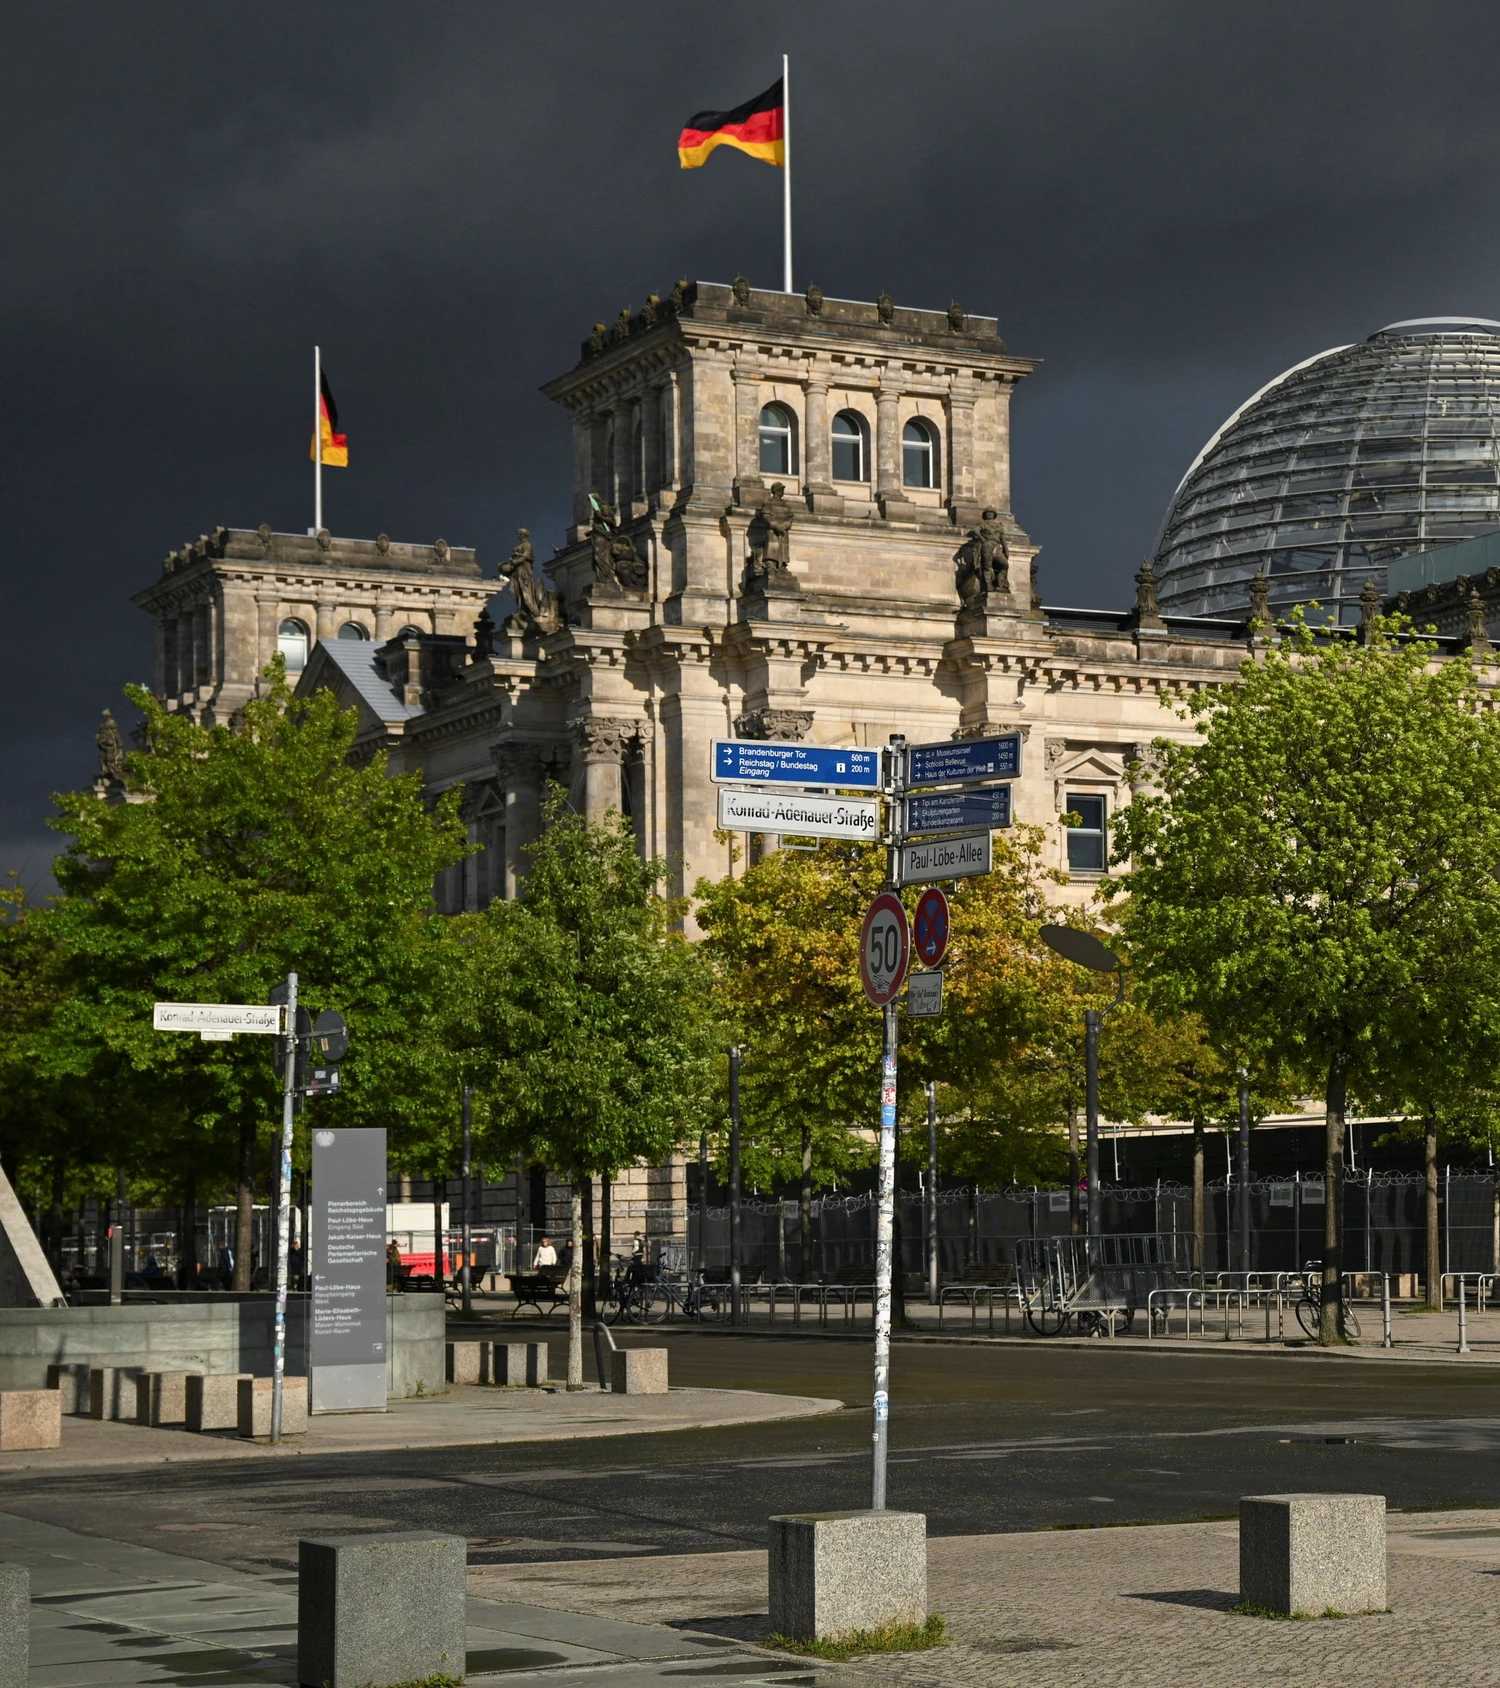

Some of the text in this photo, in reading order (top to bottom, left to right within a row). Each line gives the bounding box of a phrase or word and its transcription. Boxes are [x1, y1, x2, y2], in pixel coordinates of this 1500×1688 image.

[739, 747, 794, 759] Brandenburger
[795, 750, 807, 759] Tor
[851, 753, 863, 762] 500
[936, 746, 972, 757] Museumsinsel
[739, 758, 775, 770] Reichstag
[780, 760, 819, 772] Bundestag
[851, 764, 863, 773] 200
[925, 760, 944, 769] Schloss
[944, 758, 967, 766] Bellevue
[739, 767, 770, 777] Eingang
[924, 770, 938, 779] Haus
[938, 769, 946, 777] der
[946, 766, 966, 776] Kulturen
[966, 765, 975, 774] der
[975, 764, 987, 773] Welt
[938, 796, 966, 805] Kanzleramt
[922, 807, 961, 818] Skulpturengarten
[922, 817, 964, 827] Bundeskanzleramt
[910, 842, 983, 870] Paul-Löbe-Allee
[870, 924, 898, 975] 50
[327, 1206, 384, 1214] Reichstagsgebäude
[327, 1233, 382, 1241] Jakob-Kaiser-Haus
